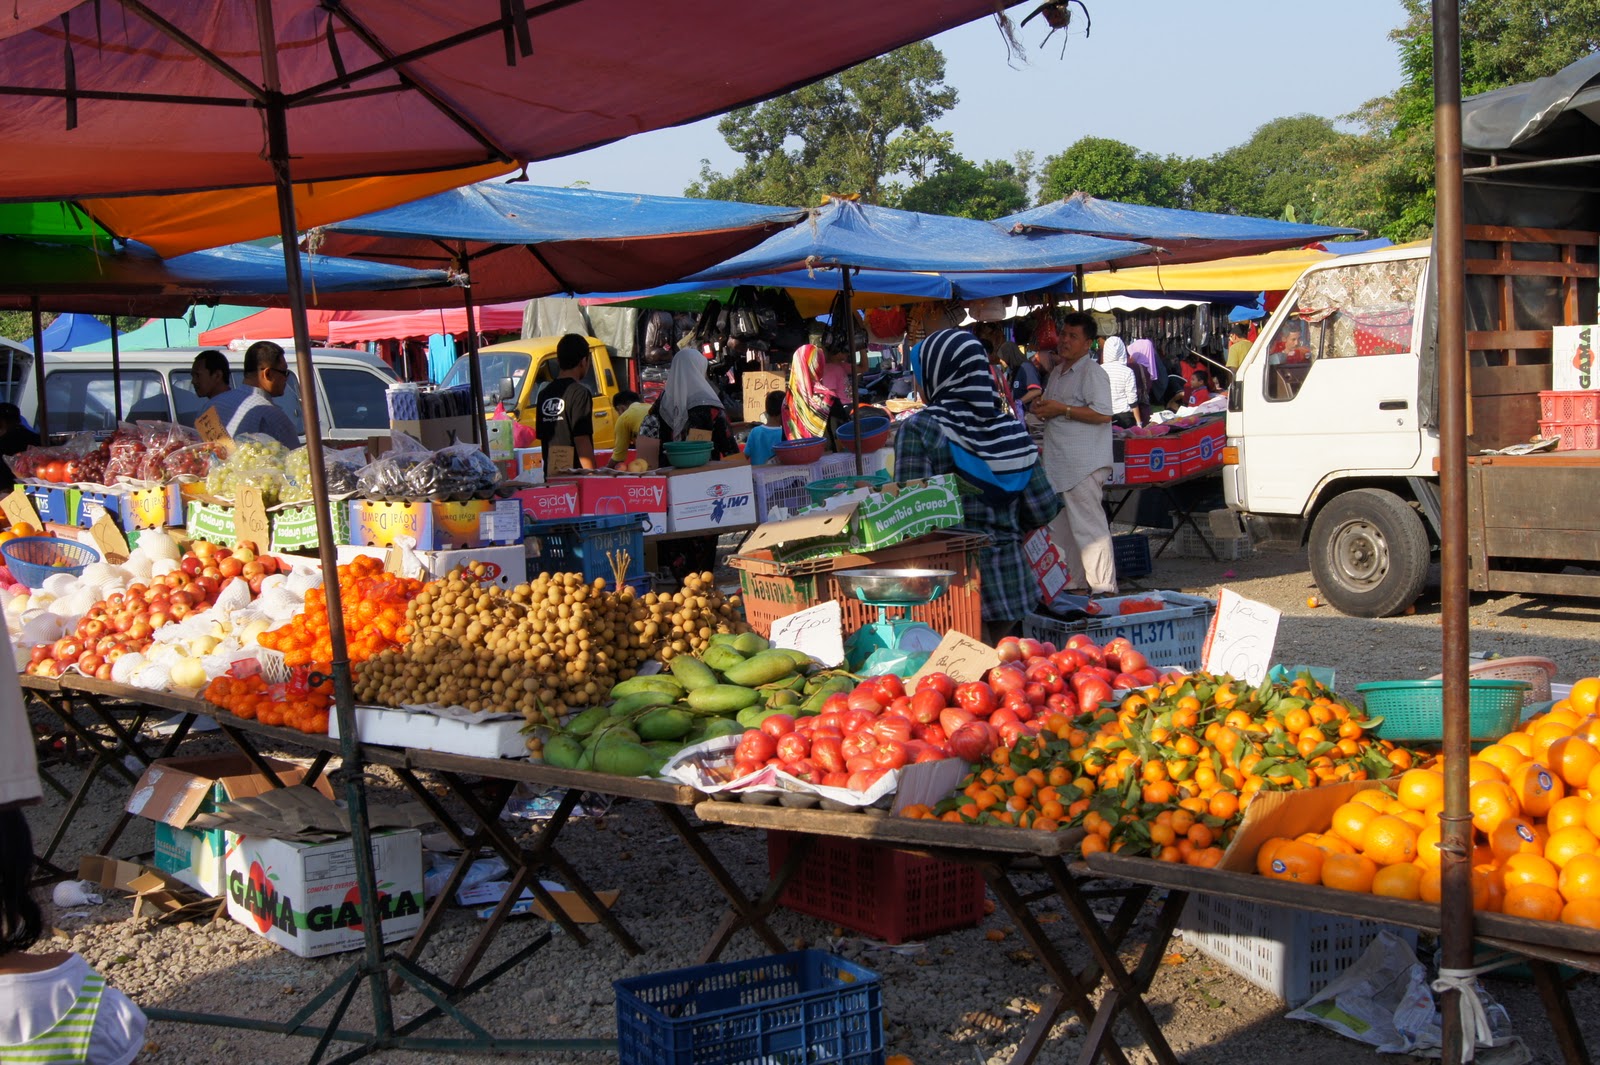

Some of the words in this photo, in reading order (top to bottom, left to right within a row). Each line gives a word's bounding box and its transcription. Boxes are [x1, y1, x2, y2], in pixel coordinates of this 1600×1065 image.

[1579, 328, 1591, 389] GAMA
[754, 378, 780, 391] BAG
[538, 492, 577, 515] Apple
[628, 485, 664, 507] Apple
[200, 511, 225, 531] Grapes
[361, 511, 387, 530] Dawn
[390, 512, 417, 532] Royal
[440, 511, 456, 522] Dawn
[457, 511, 476, 523] Royal
[875, 506, 913, 533] Namibia
[914, 498, 948, 513] Grapes
[278, 526, 300, 540] Grapes
[306, 884, 333, 895] COMPACT
[334, 880, 361, 891] OVERSEA
[230, 869, 298, 938] GAMA
